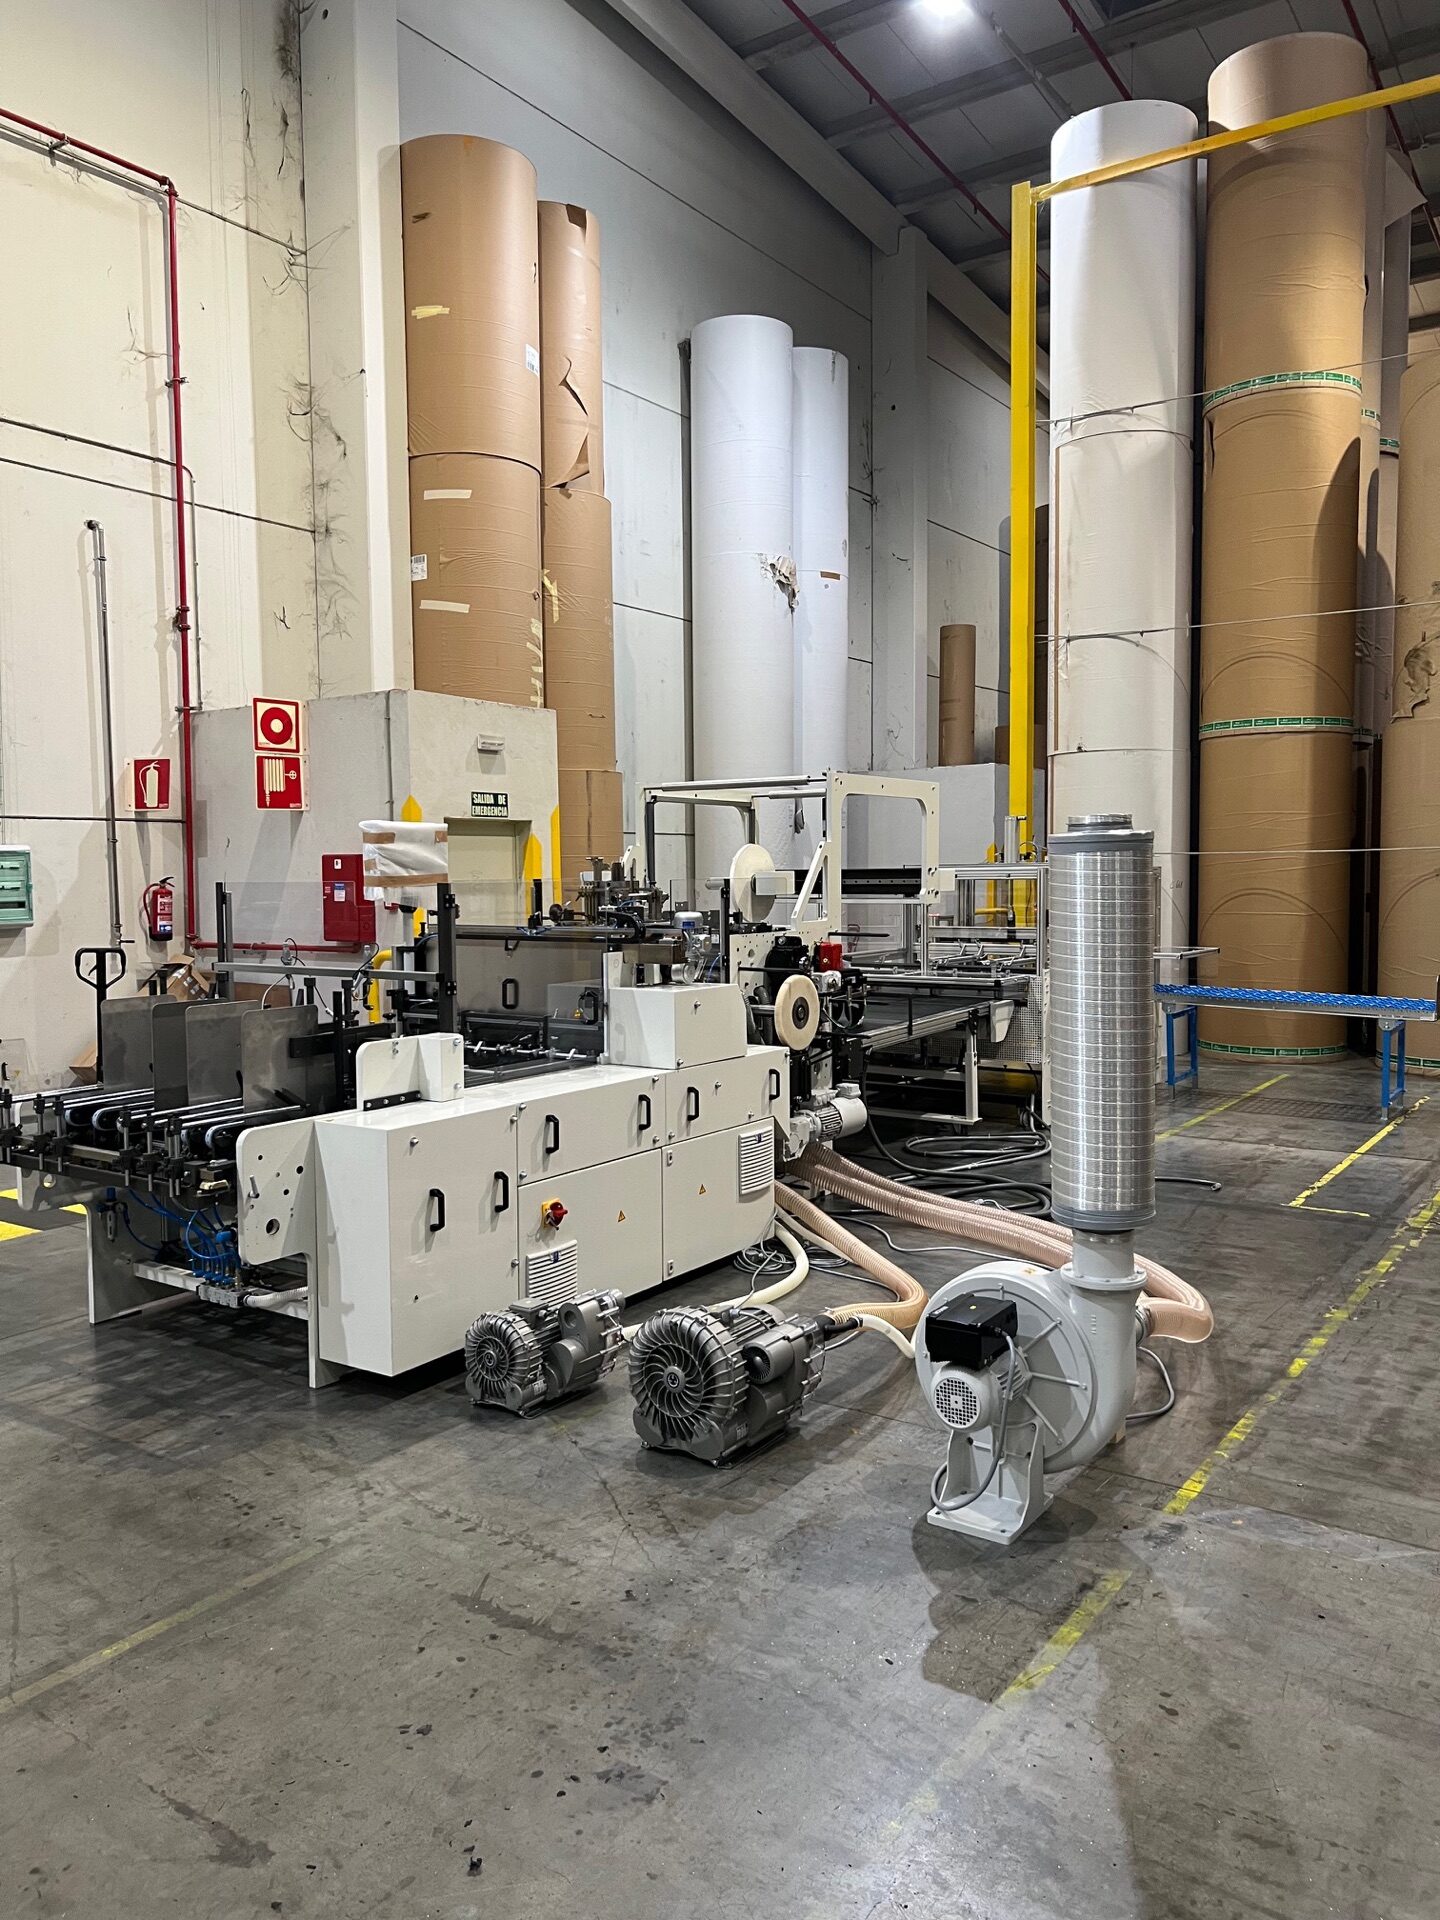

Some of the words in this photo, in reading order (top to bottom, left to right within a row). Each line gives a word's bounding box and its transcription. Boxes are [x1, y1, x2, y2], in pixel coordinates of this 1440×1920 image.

[473, 793, 494, 804] SALIDA
[498, 794, 506, 805] DE
[472, 805, 508, 816] EMERGENCIA
